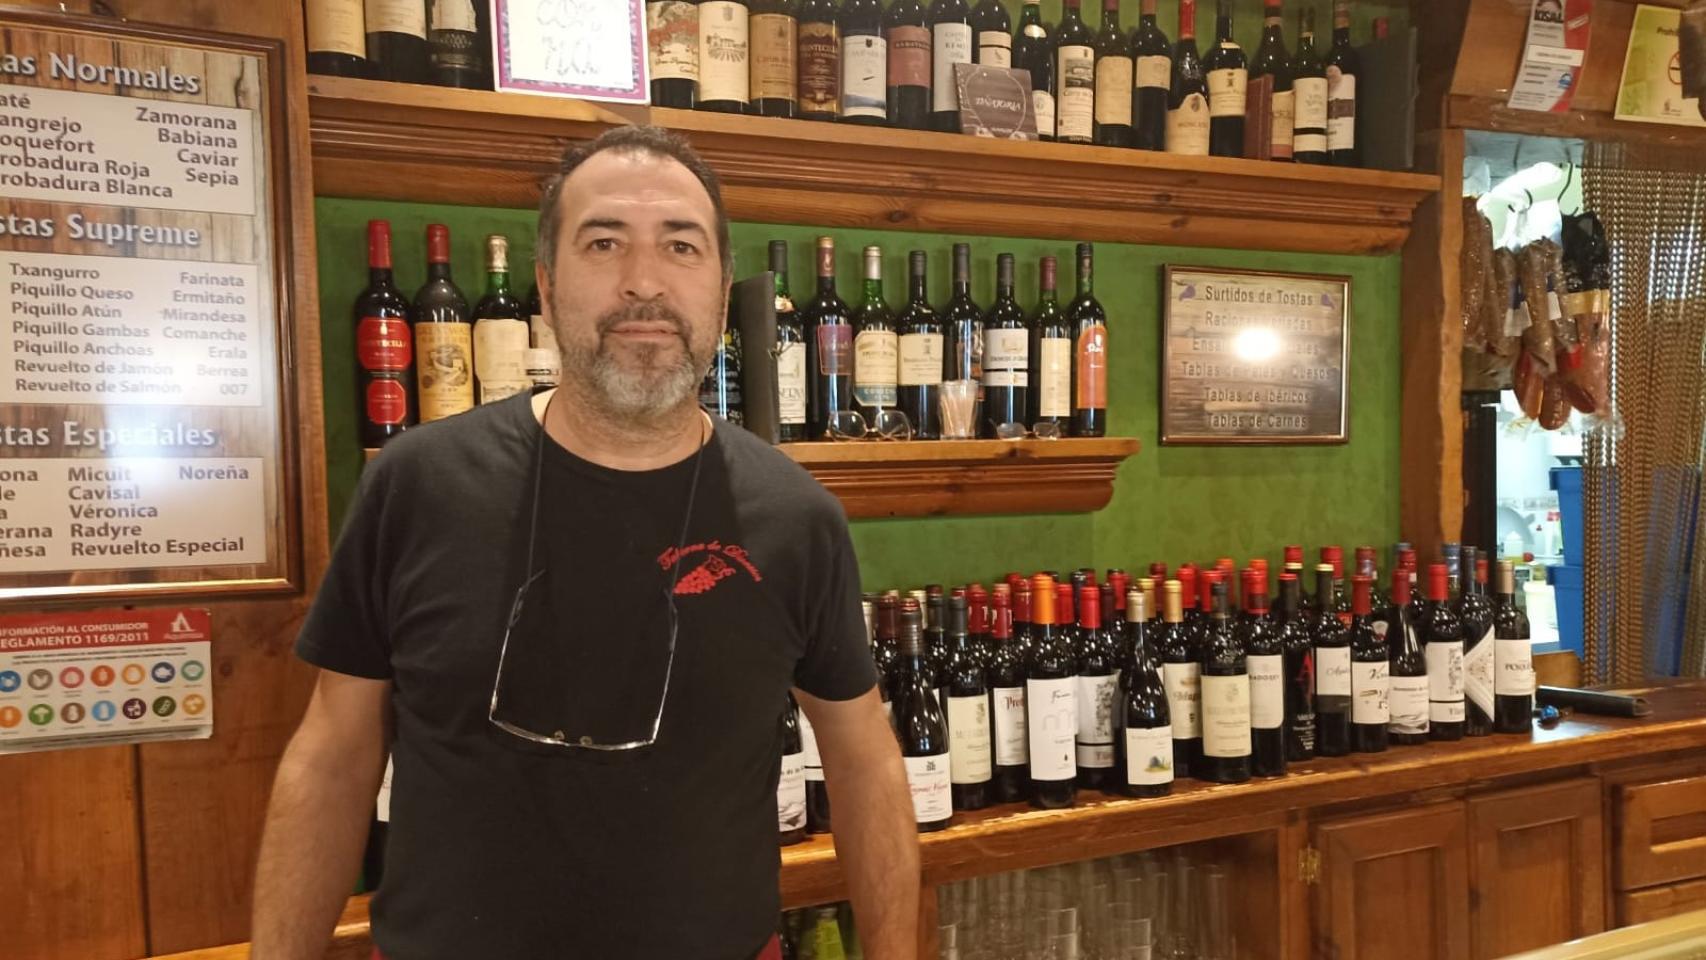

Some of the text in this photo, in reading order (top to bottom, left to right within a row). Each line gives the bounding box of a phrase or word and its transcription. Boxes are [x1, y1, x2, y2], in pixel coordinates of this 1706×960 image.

[50, 52, 201, 94] Normales
[0, 114, 82, 136] angrejo
[135, 106, 237, 130] Zamorana
[0, 134, 95, 154] oquefort
[158, 128, 237, 148] Babiana
[0, 152, 150, 178] robadura Roja
[177, 149, 239, 167] Caviar
[1, 171, 173, 198] robadura Blanca
[185, 168, 239, 187] Sepia
[66, 213, 201, 248] Supreme
[9, 263, 100, 281] Txangurro
[180, 272, 244, 287] Farinata
[10, 282, 134, 302] Piquillo Queso
[173, 289, 245, 305] Ermitaño
[1205, 285, 1314, 306] Surtidos de Tostas
[11, 301, 122, 320] Piquillo Atún
[161, 308, 246, 323] Mirandesa
[12, 320, 149, 339] Piquillo Gambas
[162, 325, 247, 341] Comanche
[13, 339, 153, 358] Piquillo Anchoas
[208, 345, 248, 360] Erala
[14, 359, 91, 374] Revuelto
[94, 358, 116, 374] de
[1182, 361, 1221, 379] Tablas
[15, 378, 93, 393] Revuelto
[97, 378, 117, 393] de
[219, 382, 248, 396] 007
[1204, 387, 1243, 404] Tablas
[1247, 390, 1261, 404] de
[1207, 412, 1307, 429] Tablas de Carnes
[62, 419, 220, 451] Especiales
[67, 466, 132, 482] Micuit
[178, 463, 250, 480] Noreña
[68, 485, 141, 500] Cavisal
[69, 504, 159, 520] Véronica
[71, 523, 143, 541] Radyre
[71, 537, 245, 557] Revuelto Especial
[67, 624, 80, 635] AL
[81, 622, 149, 634] CONSUMIDOR
[86, 632, 149, 644] 1169/2011
